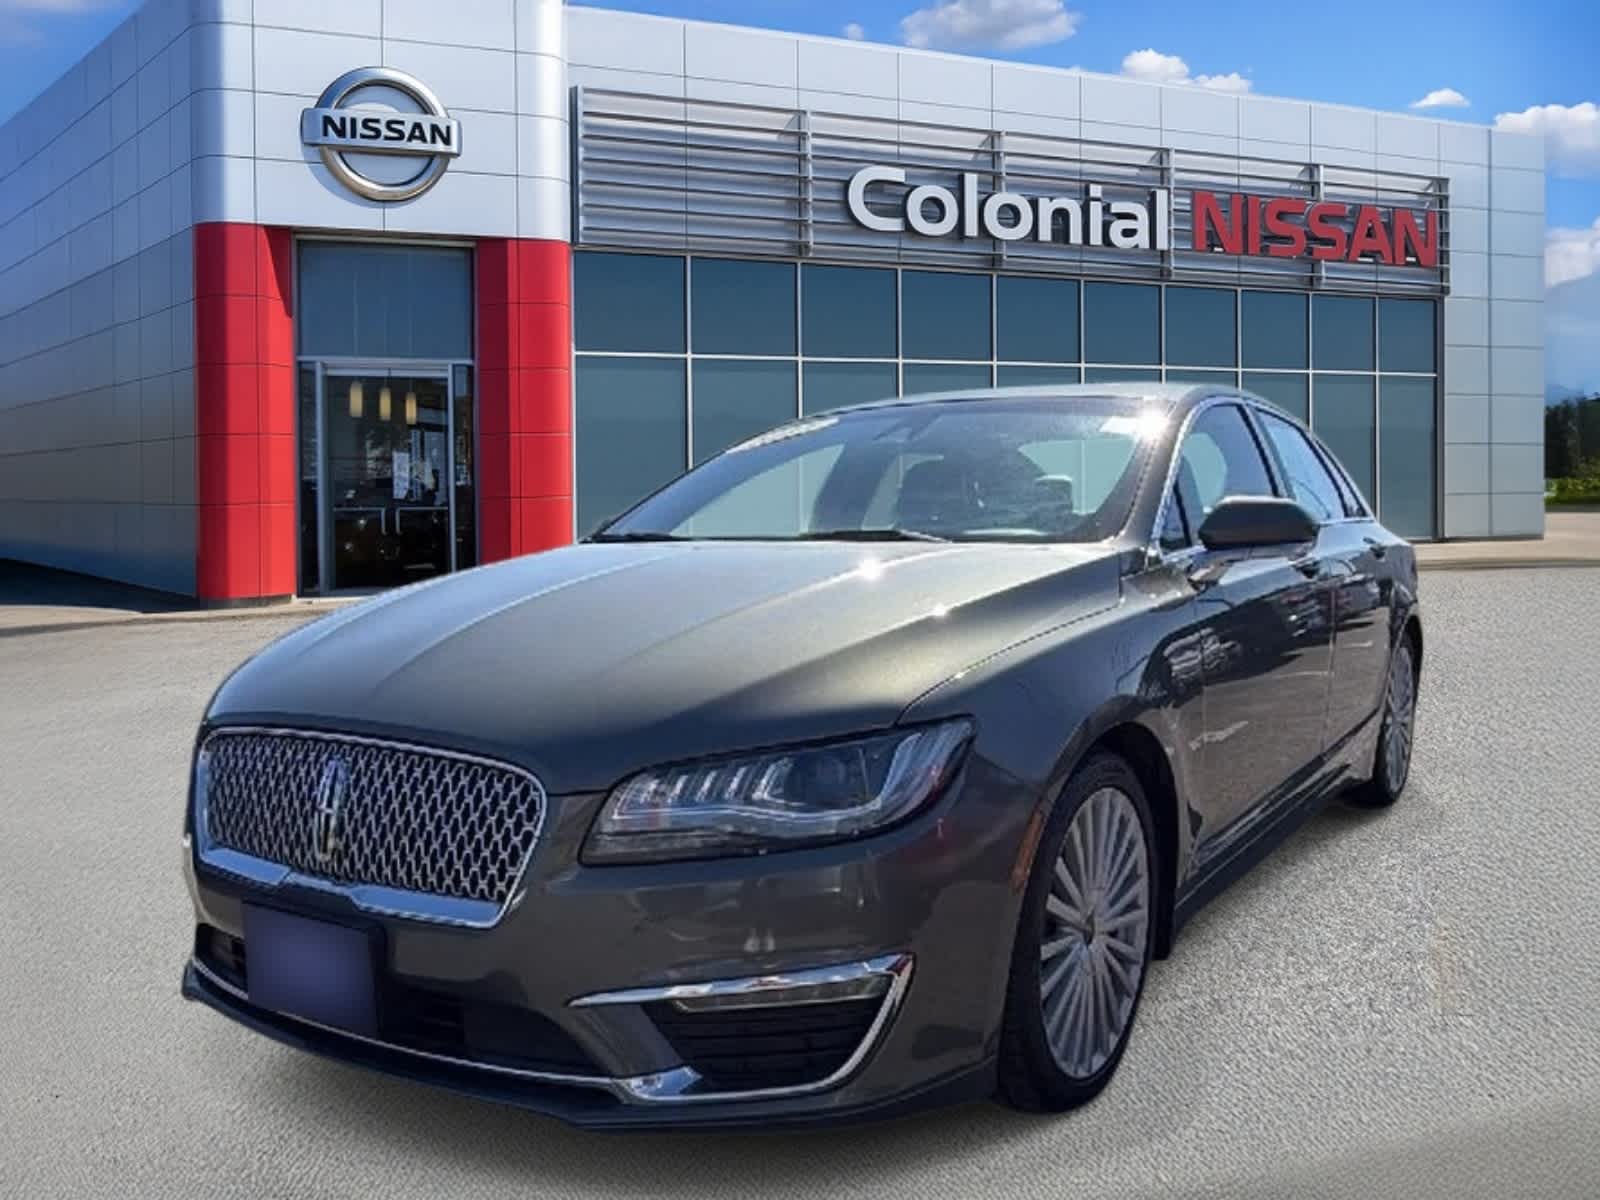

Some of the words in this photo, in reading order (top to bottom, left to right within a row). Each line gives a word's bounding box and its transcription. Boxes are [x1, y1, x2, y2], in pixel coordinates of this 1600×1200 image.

[322, 115, 452, 146] NISSAN
[847, 165, 1169, 251] Colonial
[1192, 190, 1438, 267] NISSAN
